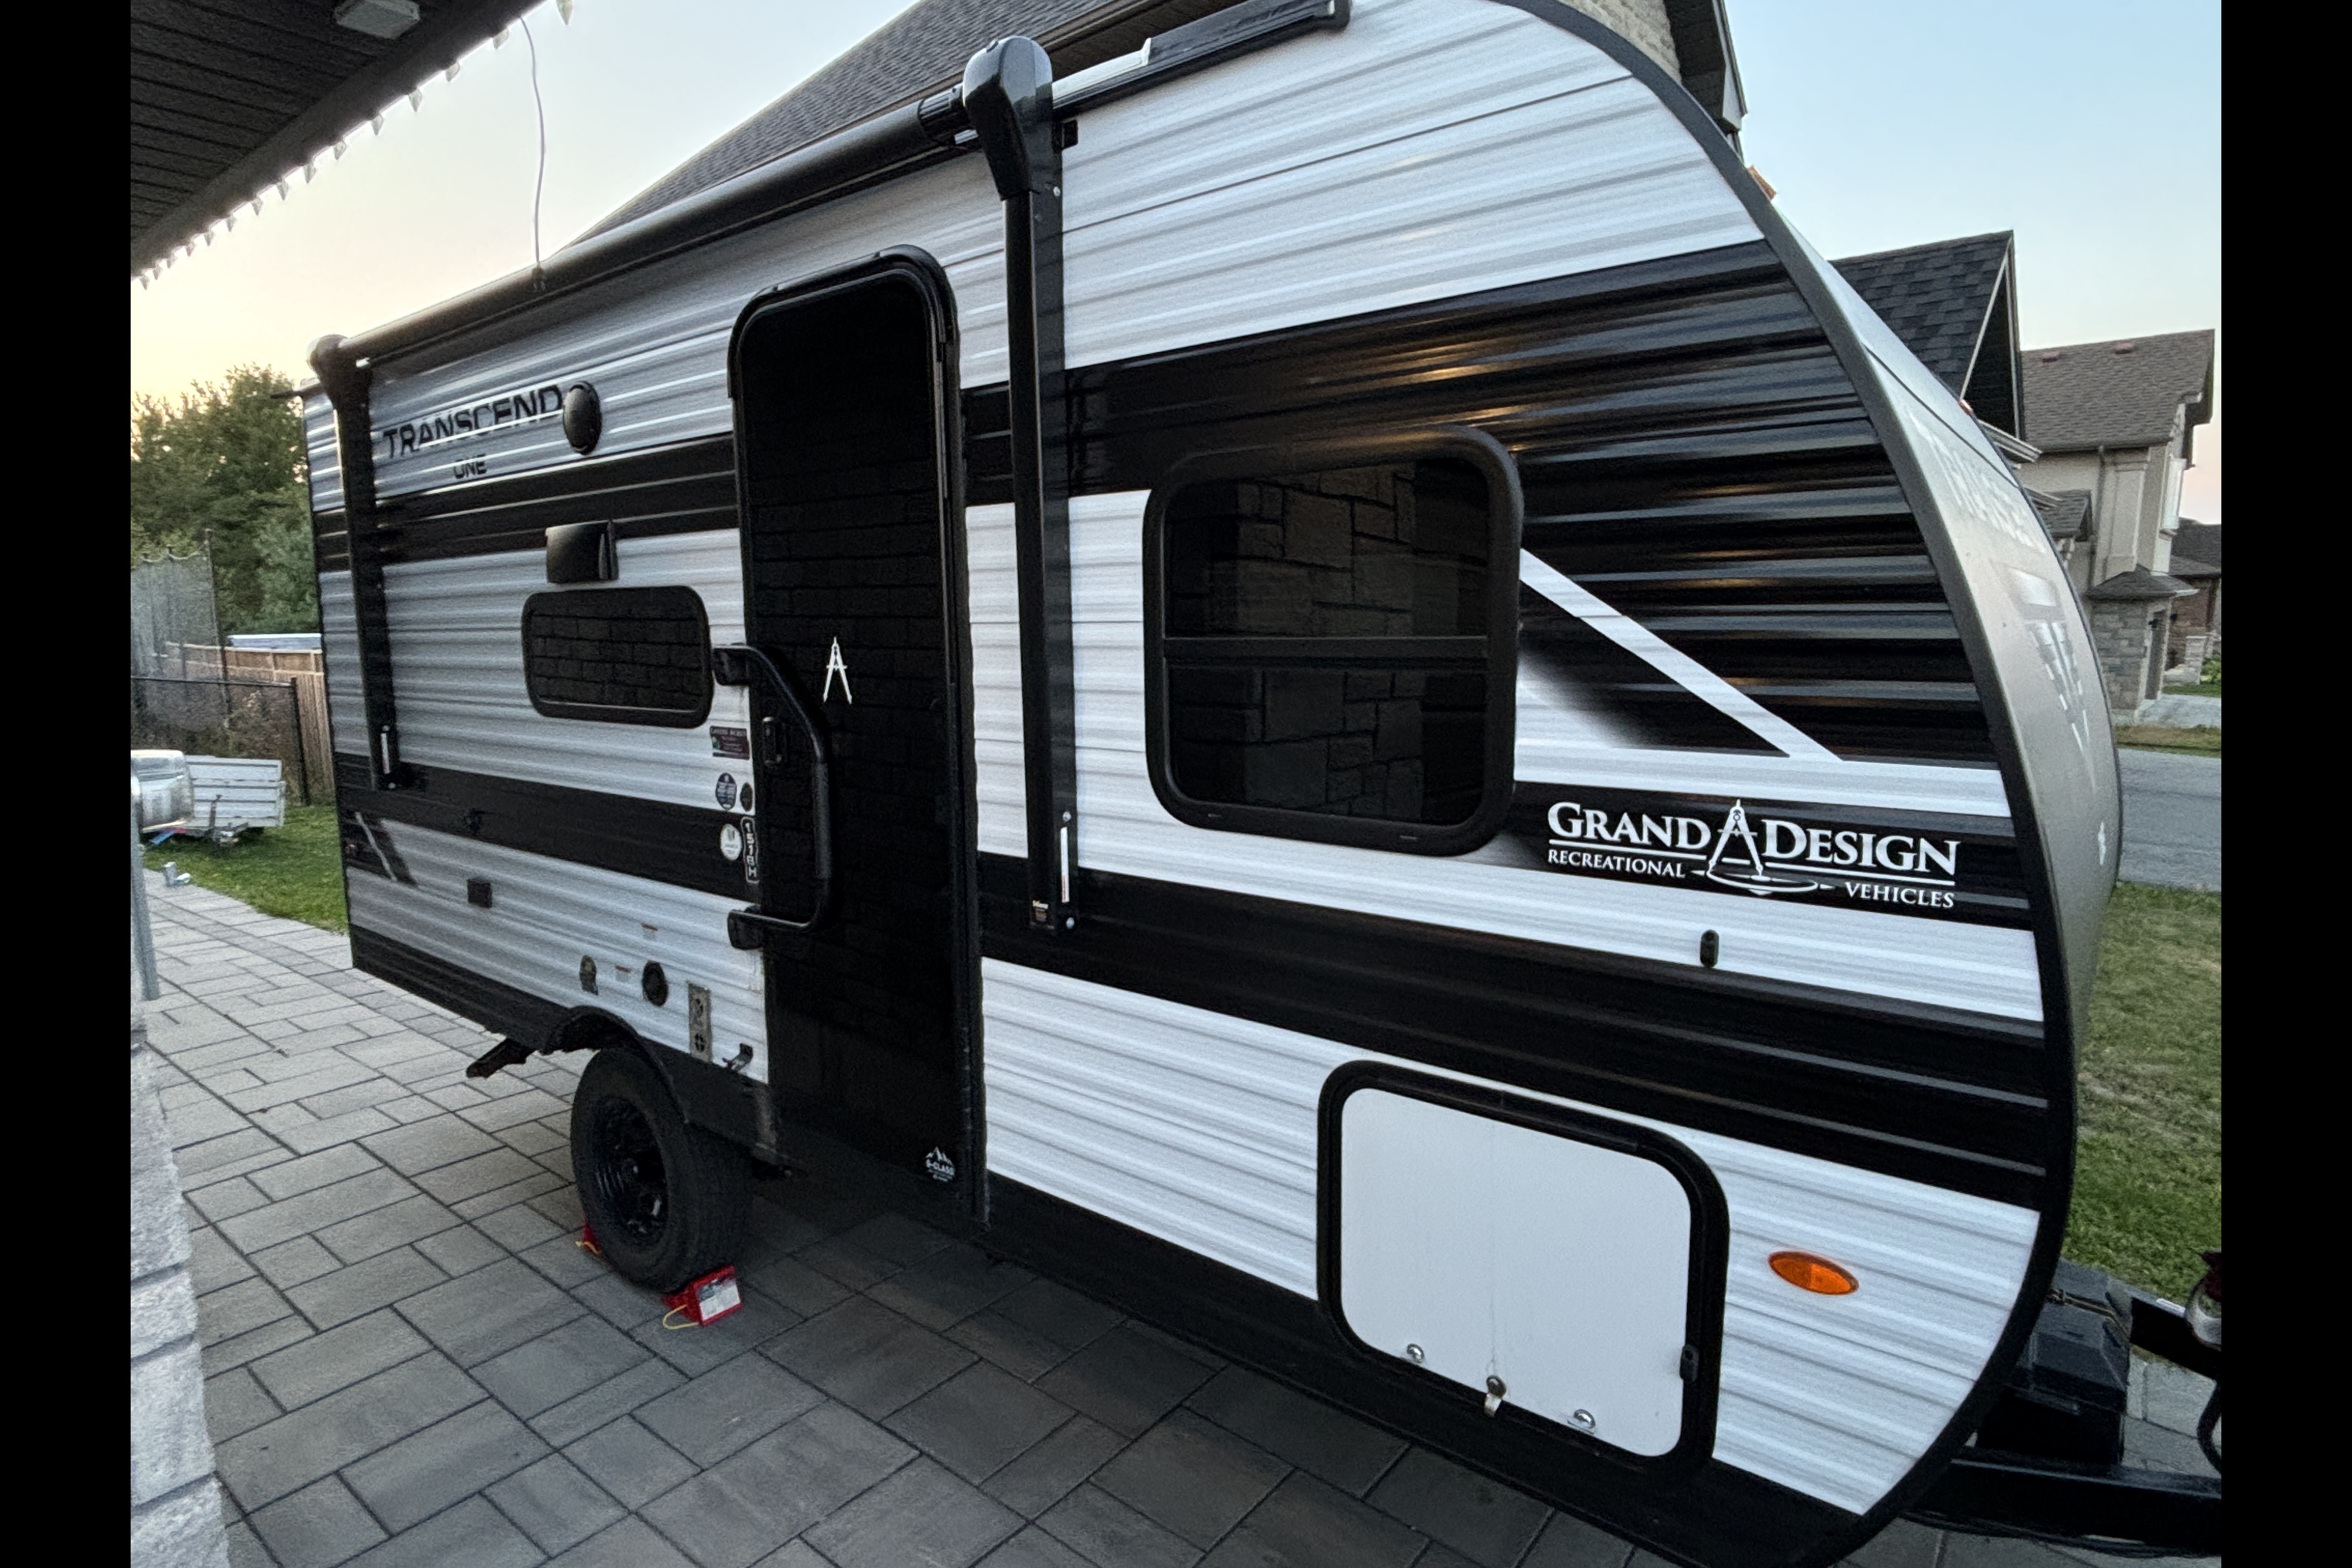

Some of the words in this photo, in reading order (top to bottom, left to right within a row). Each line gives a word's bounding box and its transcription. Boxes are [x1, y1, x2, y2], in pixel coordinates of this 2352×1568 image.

[383, 384, 563, 458] TRANSCEND
[453, 454, 487, 479] ONE
[1548, 802, 1712, 850] GRAND
[1762, 819, 1961, 876] DESIGN
[1548, 849, 1685, 878] RECREATIONAL
[1844, 881, 1955, 909] VEHICLES
